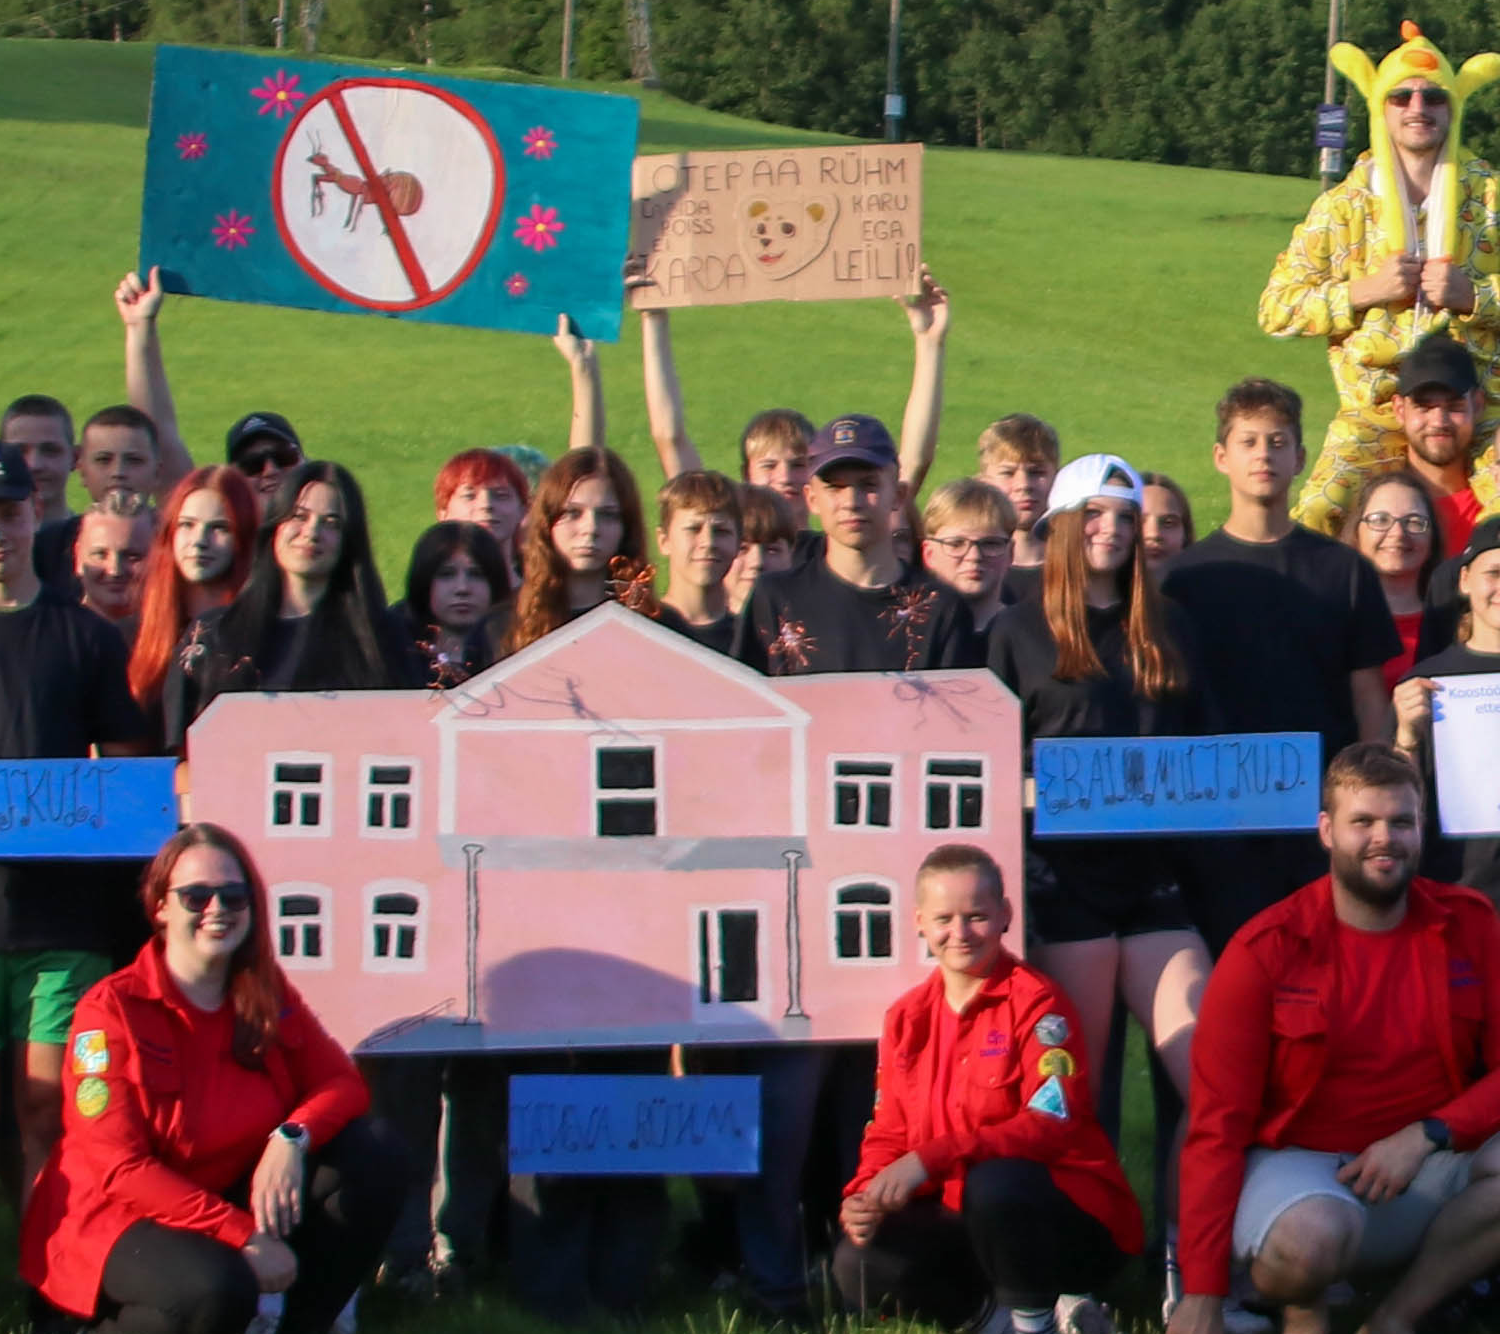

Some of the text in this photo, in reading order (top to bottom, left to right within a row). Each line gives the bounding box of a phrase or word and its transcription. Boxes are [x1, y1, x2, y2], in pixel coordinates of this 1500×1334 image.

[652, 152, 906, 192] OTEPÄÄ RÜHM
[852, 194, 909, 213] KARU
[862, 220, 905, 241] EGA
[644, 253, 746, 298] KARDA
